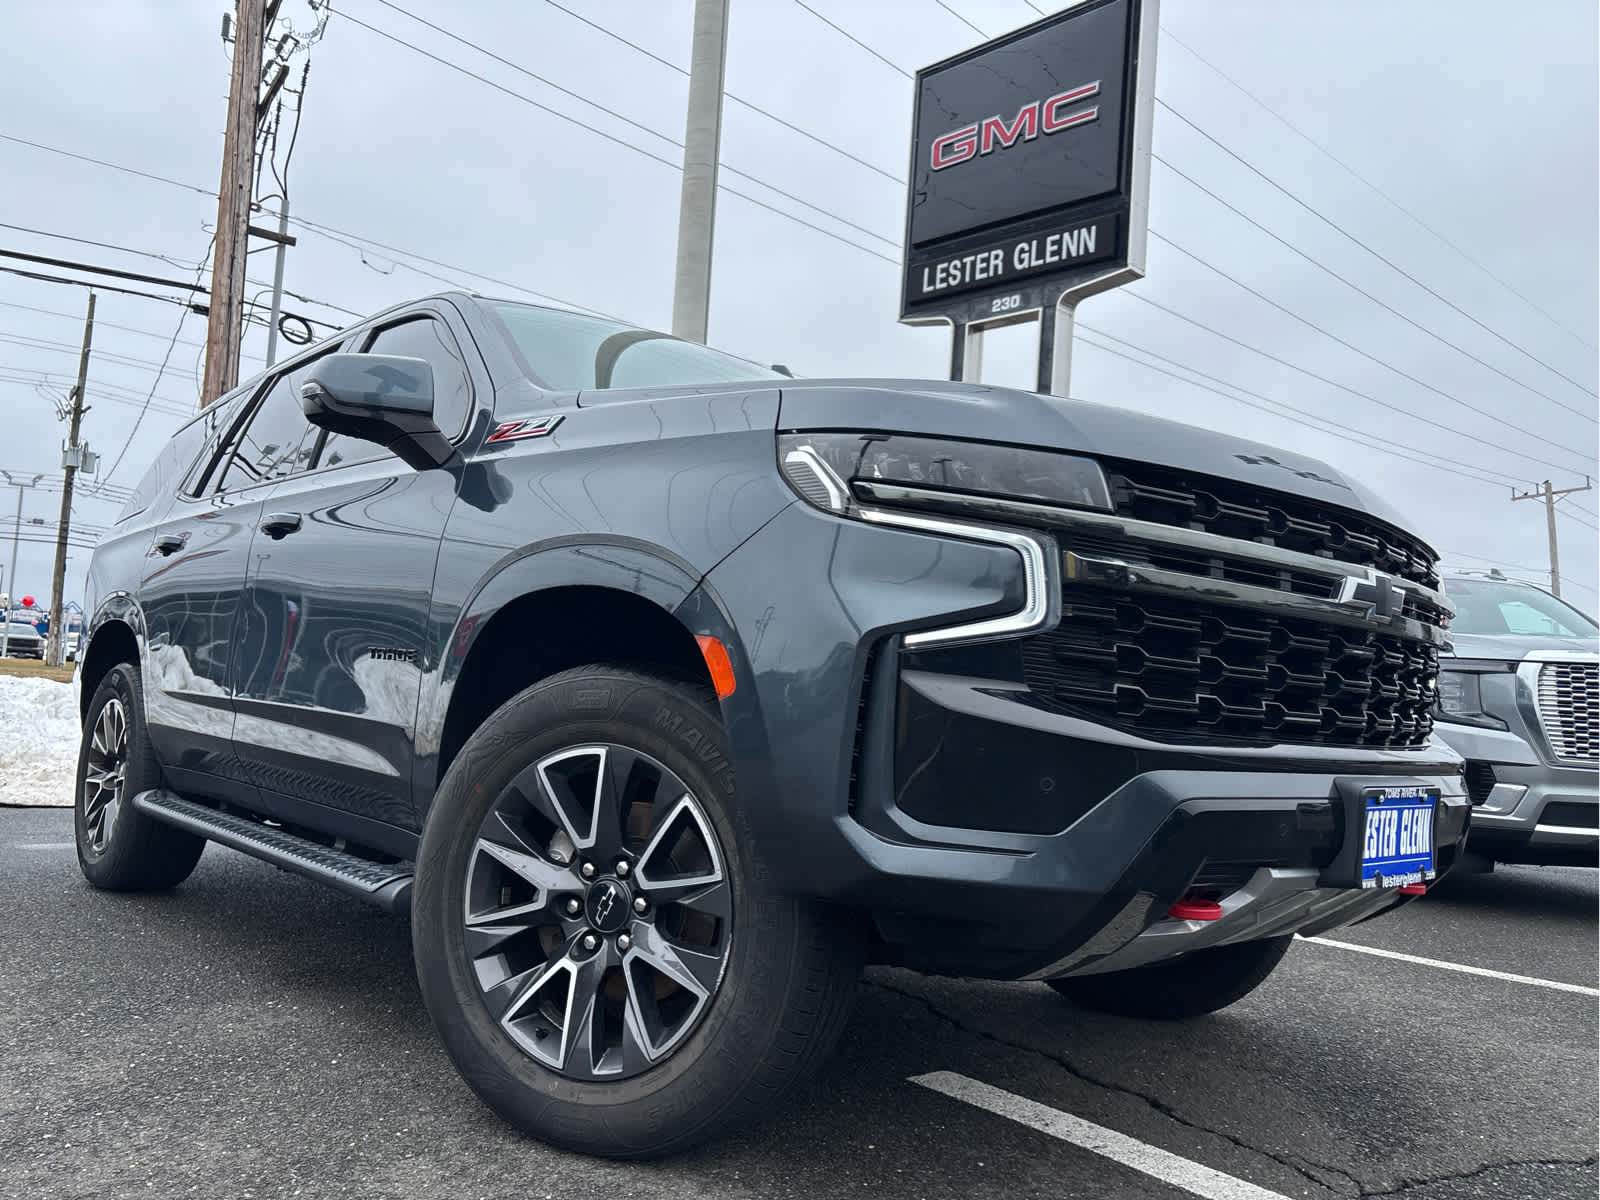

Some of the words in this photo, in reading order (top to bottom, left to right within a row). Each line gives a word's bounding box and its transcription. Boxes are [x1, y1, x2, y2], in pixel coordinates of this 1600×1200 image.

[931, 80, 1101, 170] GMC
[922, 249, 1004, 293] LESTER
[1013, 225, 1097, 270] GLENN
[992, 295, 1021, 313] 230
[368, 646, 417, 662] TAHOE
[655, 704, 736, 796] MAVIS
[1362, 809, 1398, 859] ESTER
[1400, 808, 1432, 855] GLENN
